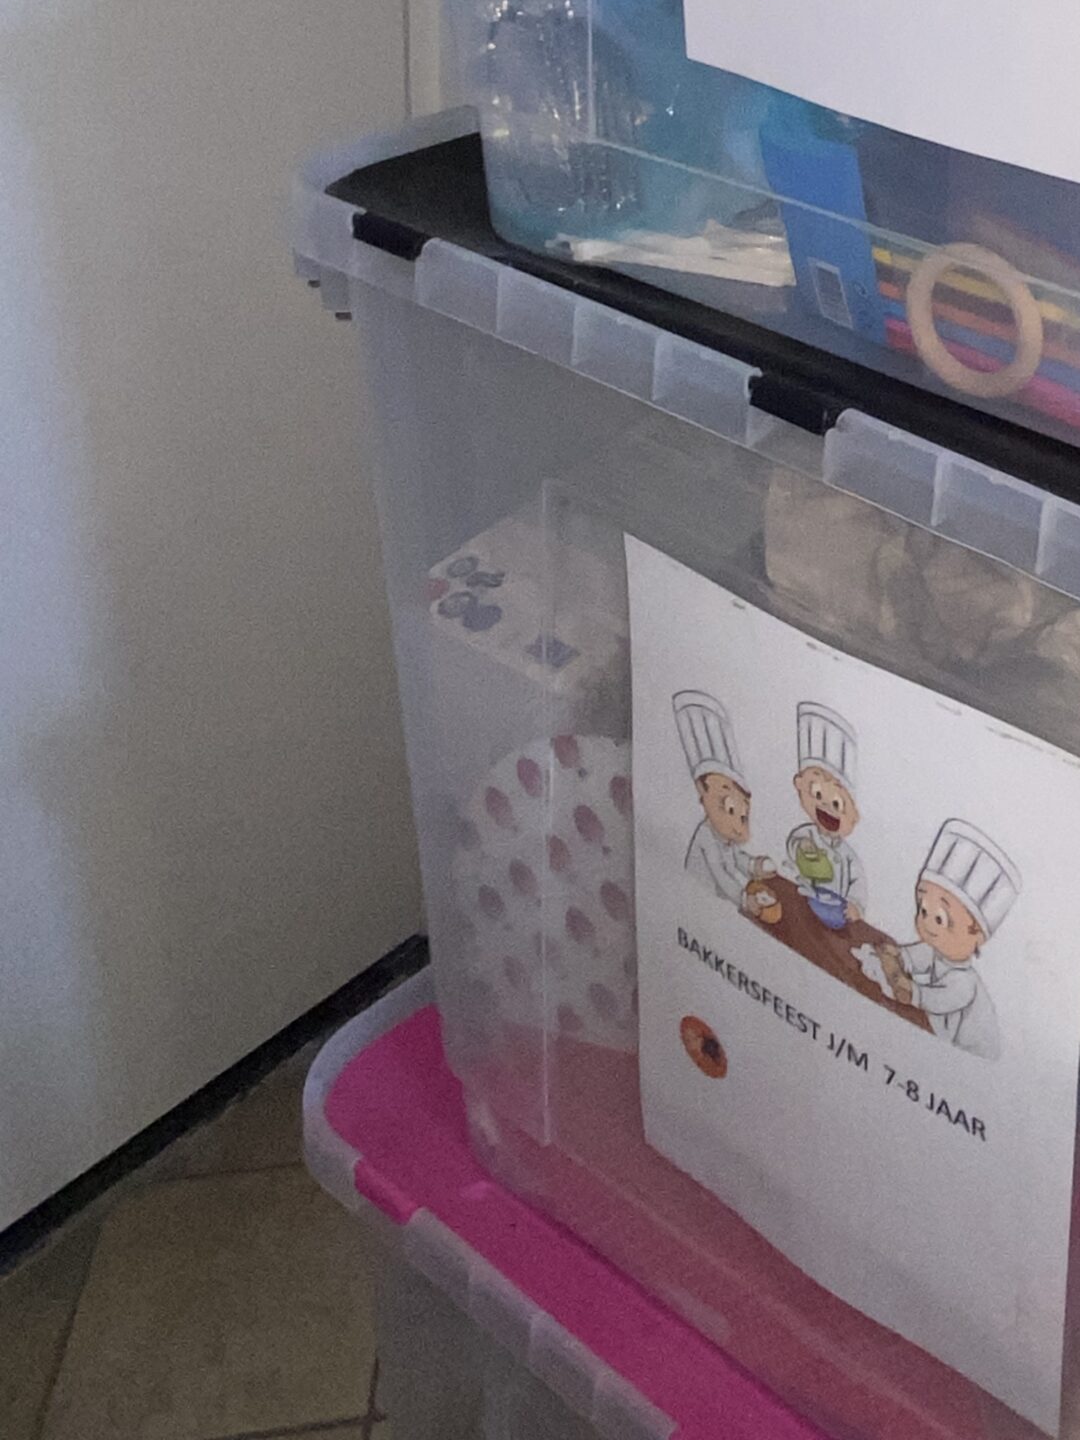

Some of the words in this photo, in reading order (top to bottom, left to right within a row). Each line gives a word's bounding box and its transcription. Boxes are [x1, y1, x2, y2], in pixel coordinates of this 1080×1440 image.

[677, 926, 821, 1040] BAKKERSFEEST
[826, 1033, 869, 1072] J/M
[883, 1064, 920, 1102] 7-8
[925, 1092, 987, 1142] JAAR
